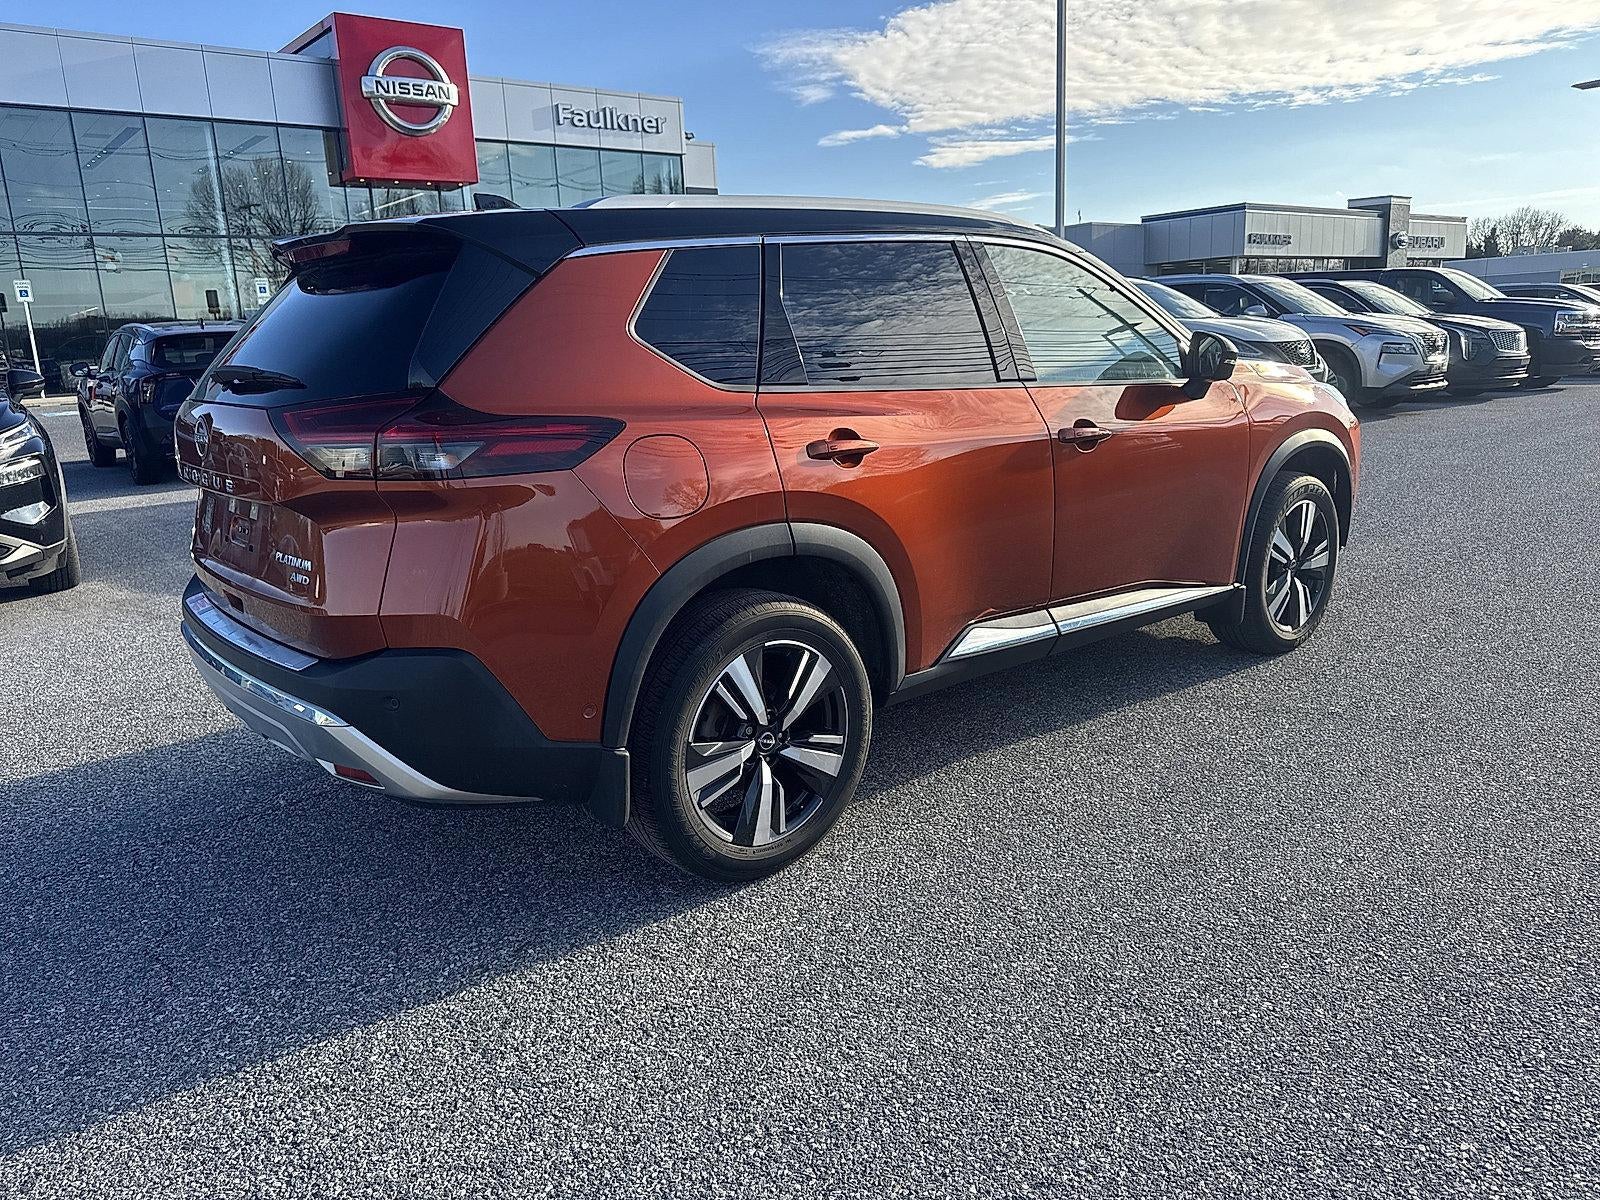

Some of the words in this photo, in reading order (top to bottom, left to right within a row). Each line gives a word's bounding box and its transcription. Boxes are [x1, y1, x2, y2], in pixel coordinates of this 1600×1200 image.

[374, 79, 451, 100] NISSAN
[555, 102, 667, 134] Faulkner
[1406, 235, 1446, 248] SUBARU
[183, 465, 234, 493] ROGUE
[275, 551, 312, 571] PLATINUM
[290, 572, 310, 585] AWD
